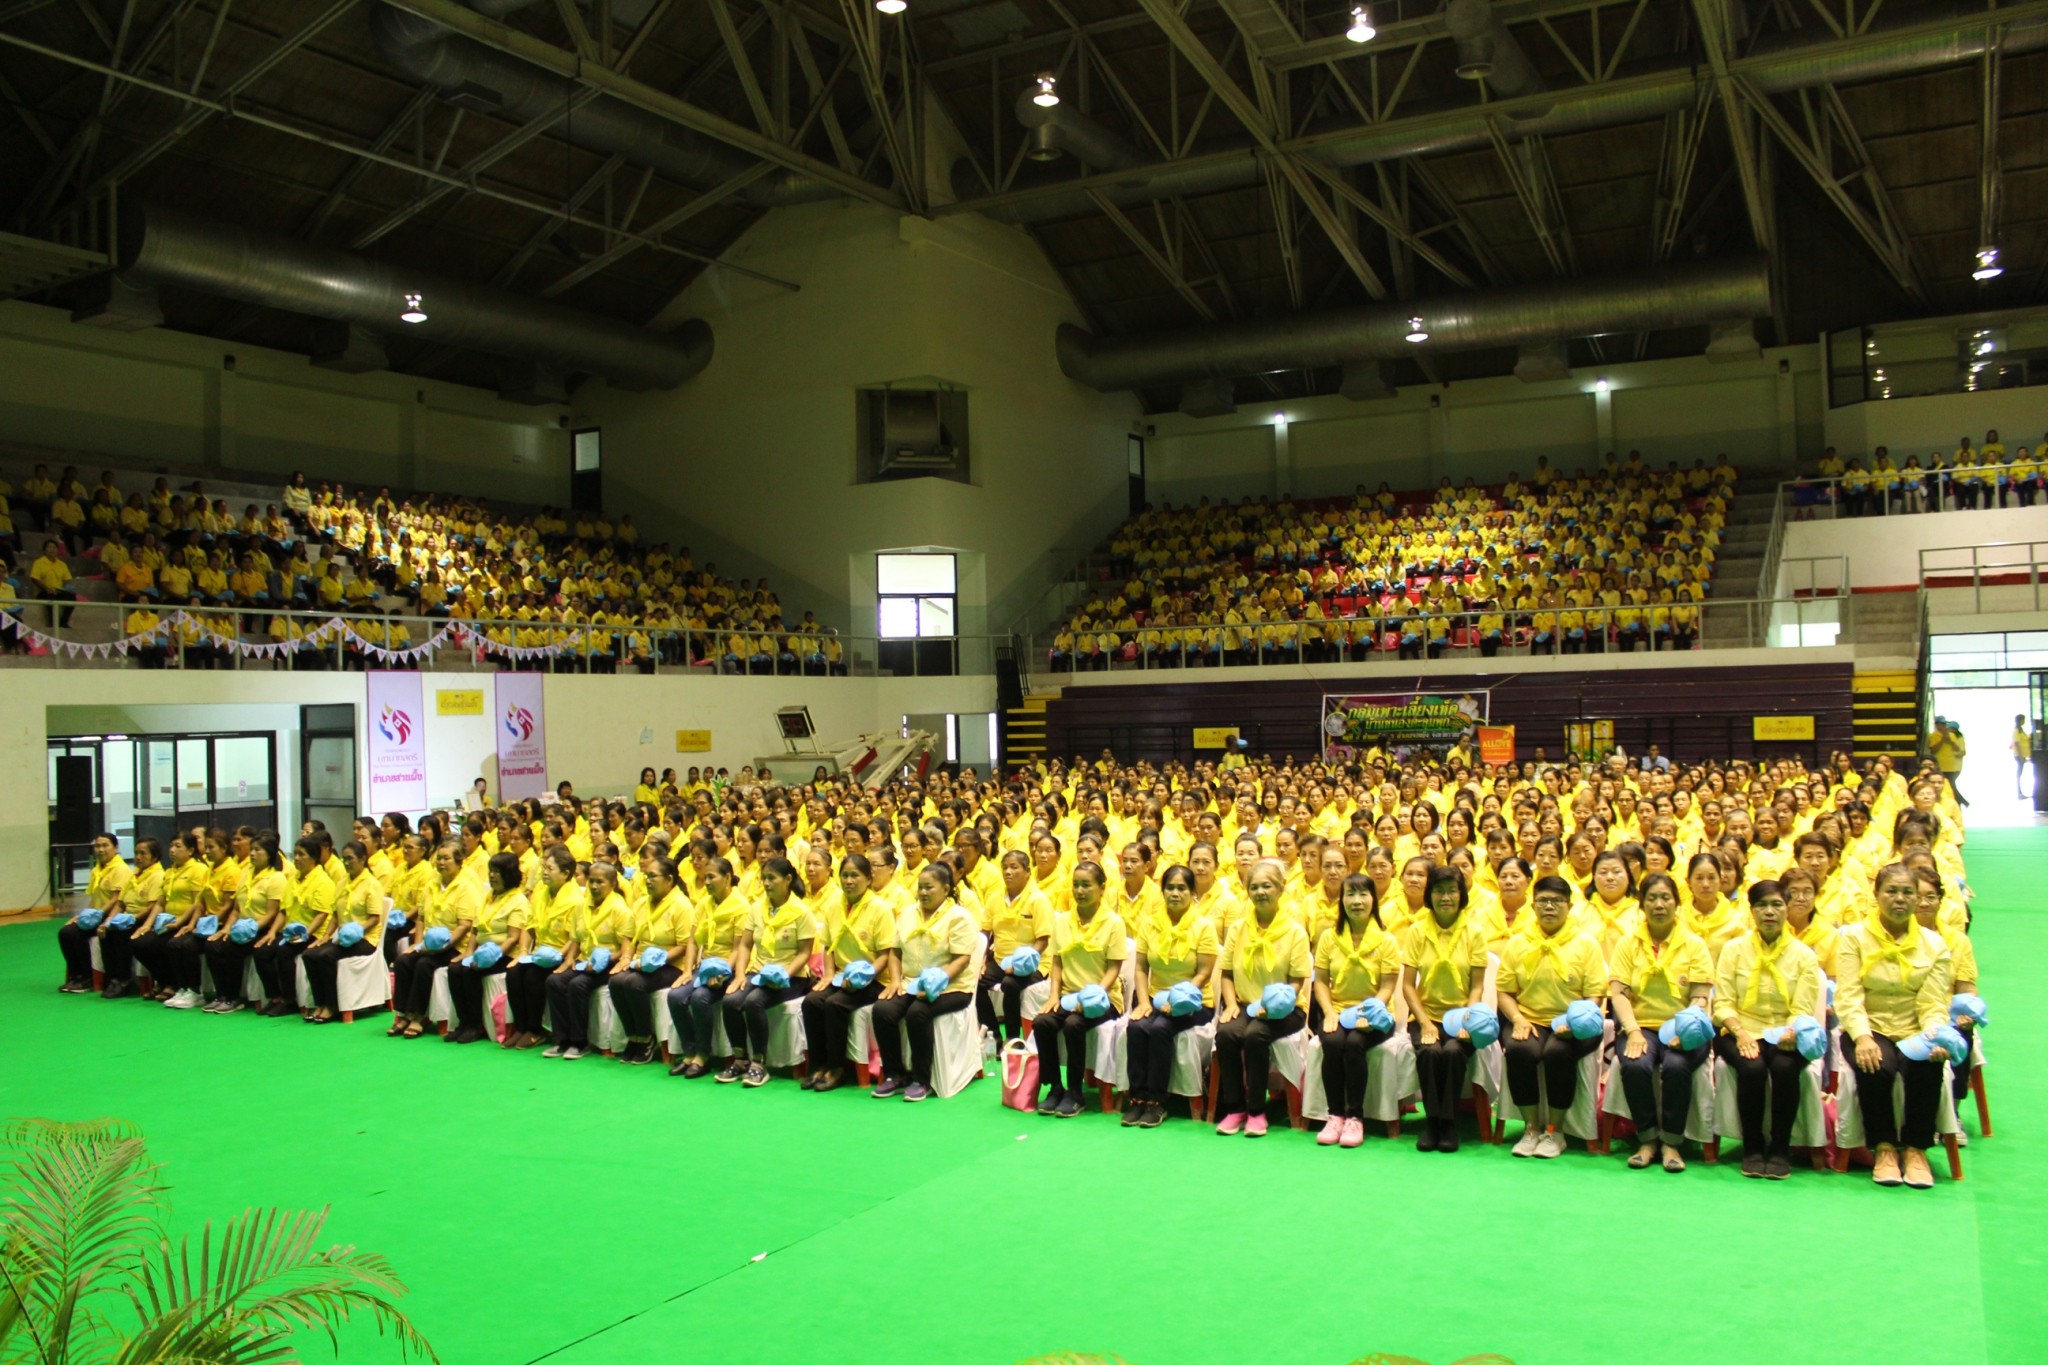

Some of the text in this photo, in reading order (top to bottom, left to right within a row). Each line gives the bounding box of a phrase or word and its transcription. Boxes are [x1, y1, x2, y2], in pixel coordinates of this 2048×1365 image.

[1349, 696, 1459, 719] กลุ่มเพาะเลี้ยงเห็ด
